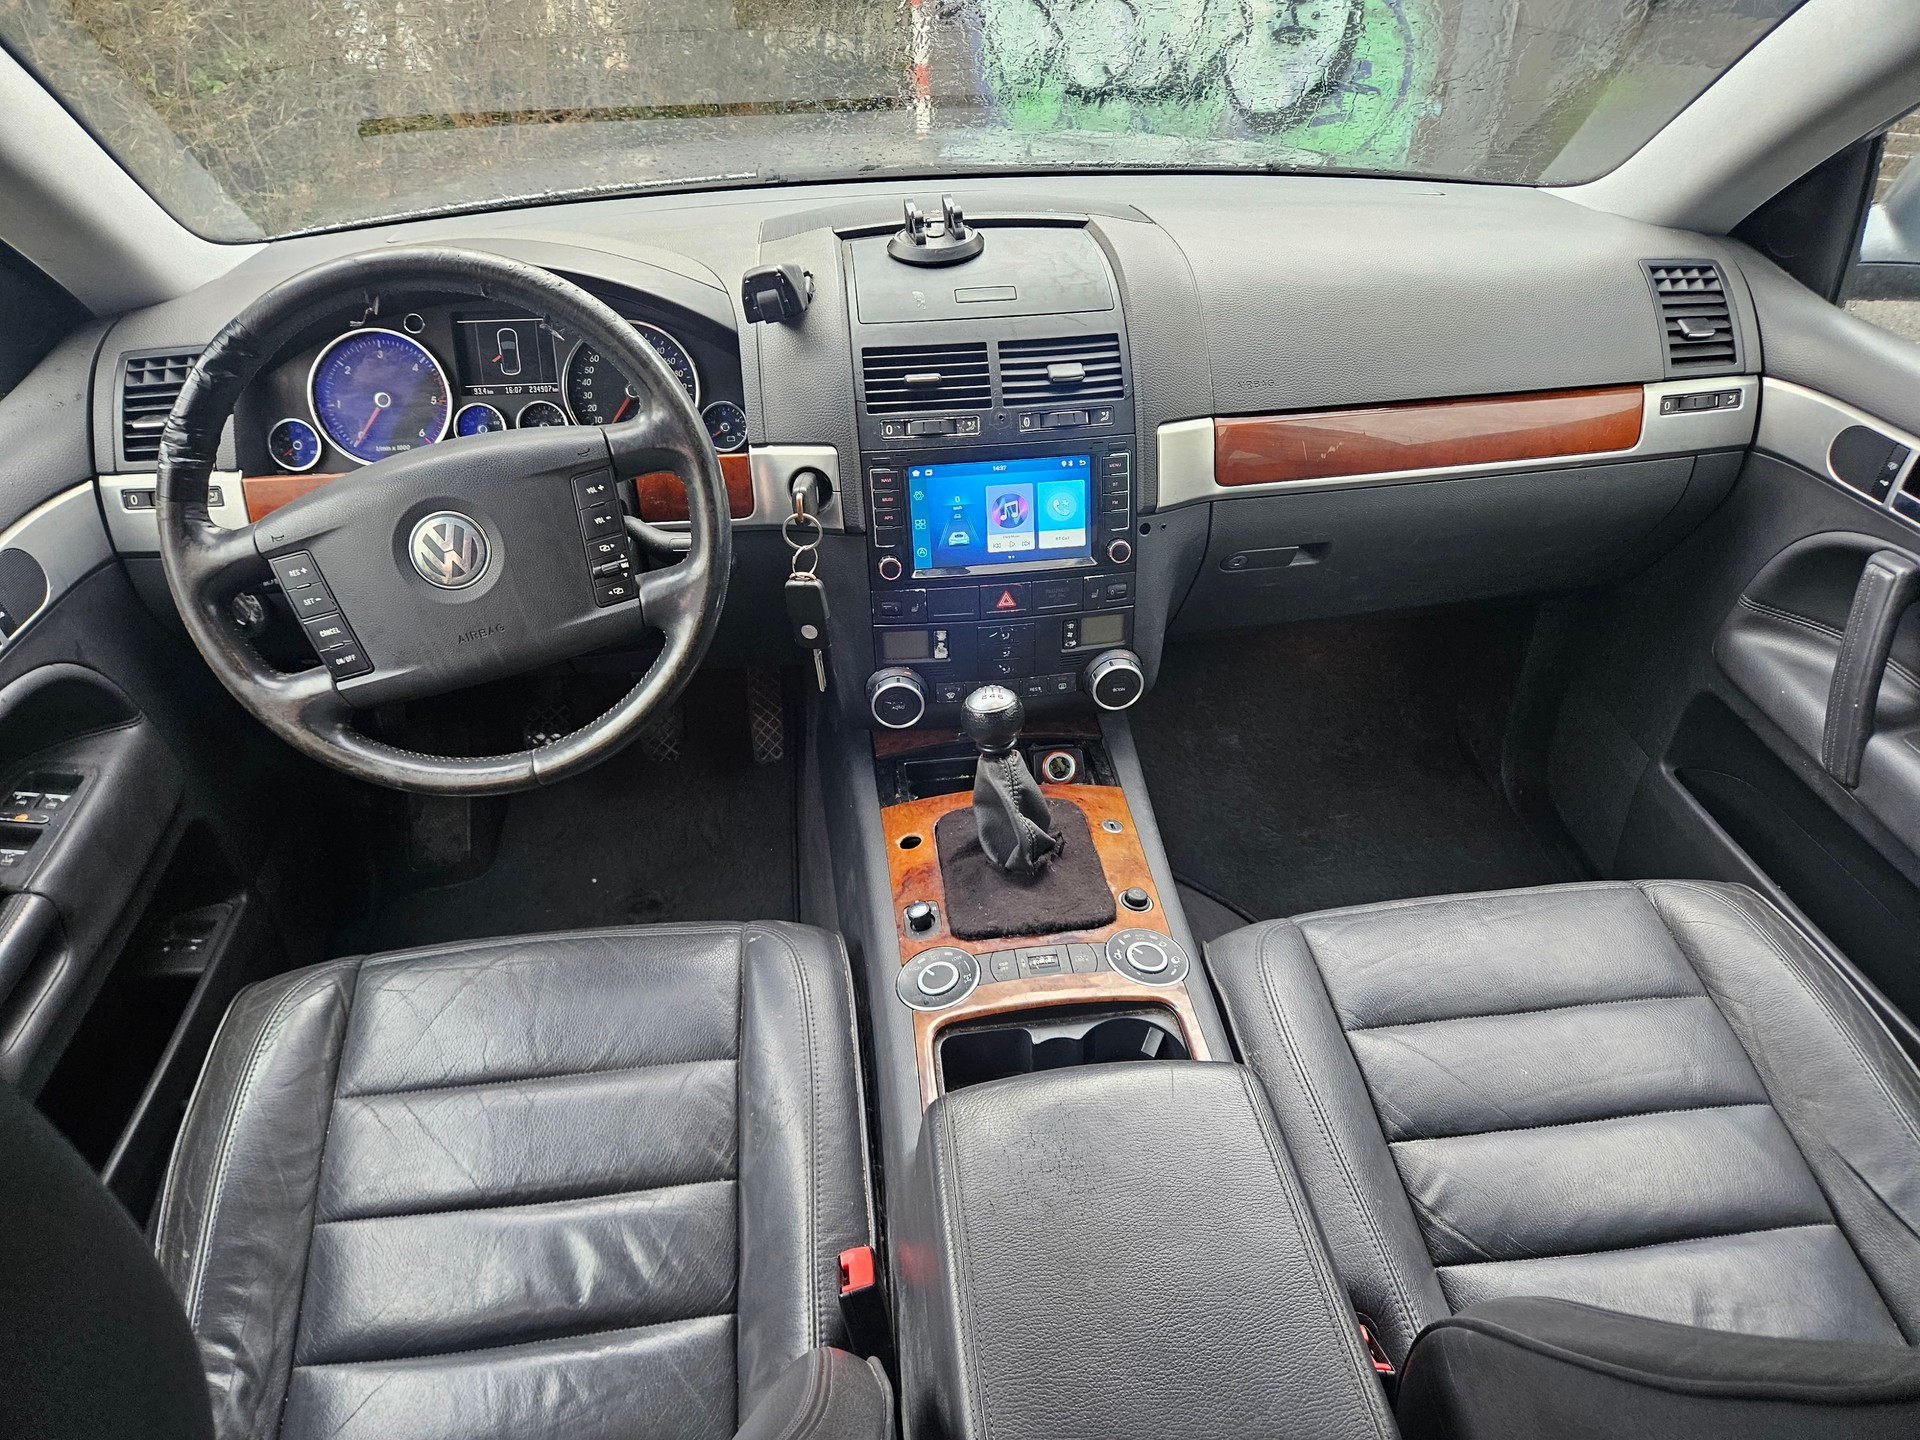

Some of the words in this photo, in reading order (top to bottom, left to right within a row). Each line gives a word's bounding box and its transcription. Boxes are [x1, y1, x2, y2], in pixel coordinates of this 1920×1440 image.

[377, 350, 383, 359] 3
[589, 355, 599, 363] 60
[345, 366, 351, 375] 2
[412, 363, 419, 372] 4
[582, 378, 592, 386] 40
[473, 387, 487, 395] 93.4
[505, 386, 522, 394] 16:07
[337, 400, 341, 409] 1
[430, 396, 437, 405] 5
[587, 404, 597, 412] 20
[1664, 401, 1671, 411] 0
[594, 416, 603, 424] 10
[1024, 417, 1030, 427] 0
[419, 428, 426, 438] 6
[885, 425, 893, 435] 0
[131, 495, 138, 505] 0
[954, 495, 960, 503] 0
[288, 569, 301, 577] RES
[303, 597, 315, 606] SET
[319, 627, 341, 638] CANCEL
[458, 623, 505, 644] AIRBAG
[335, 654, 356, 665] ON/OFF
